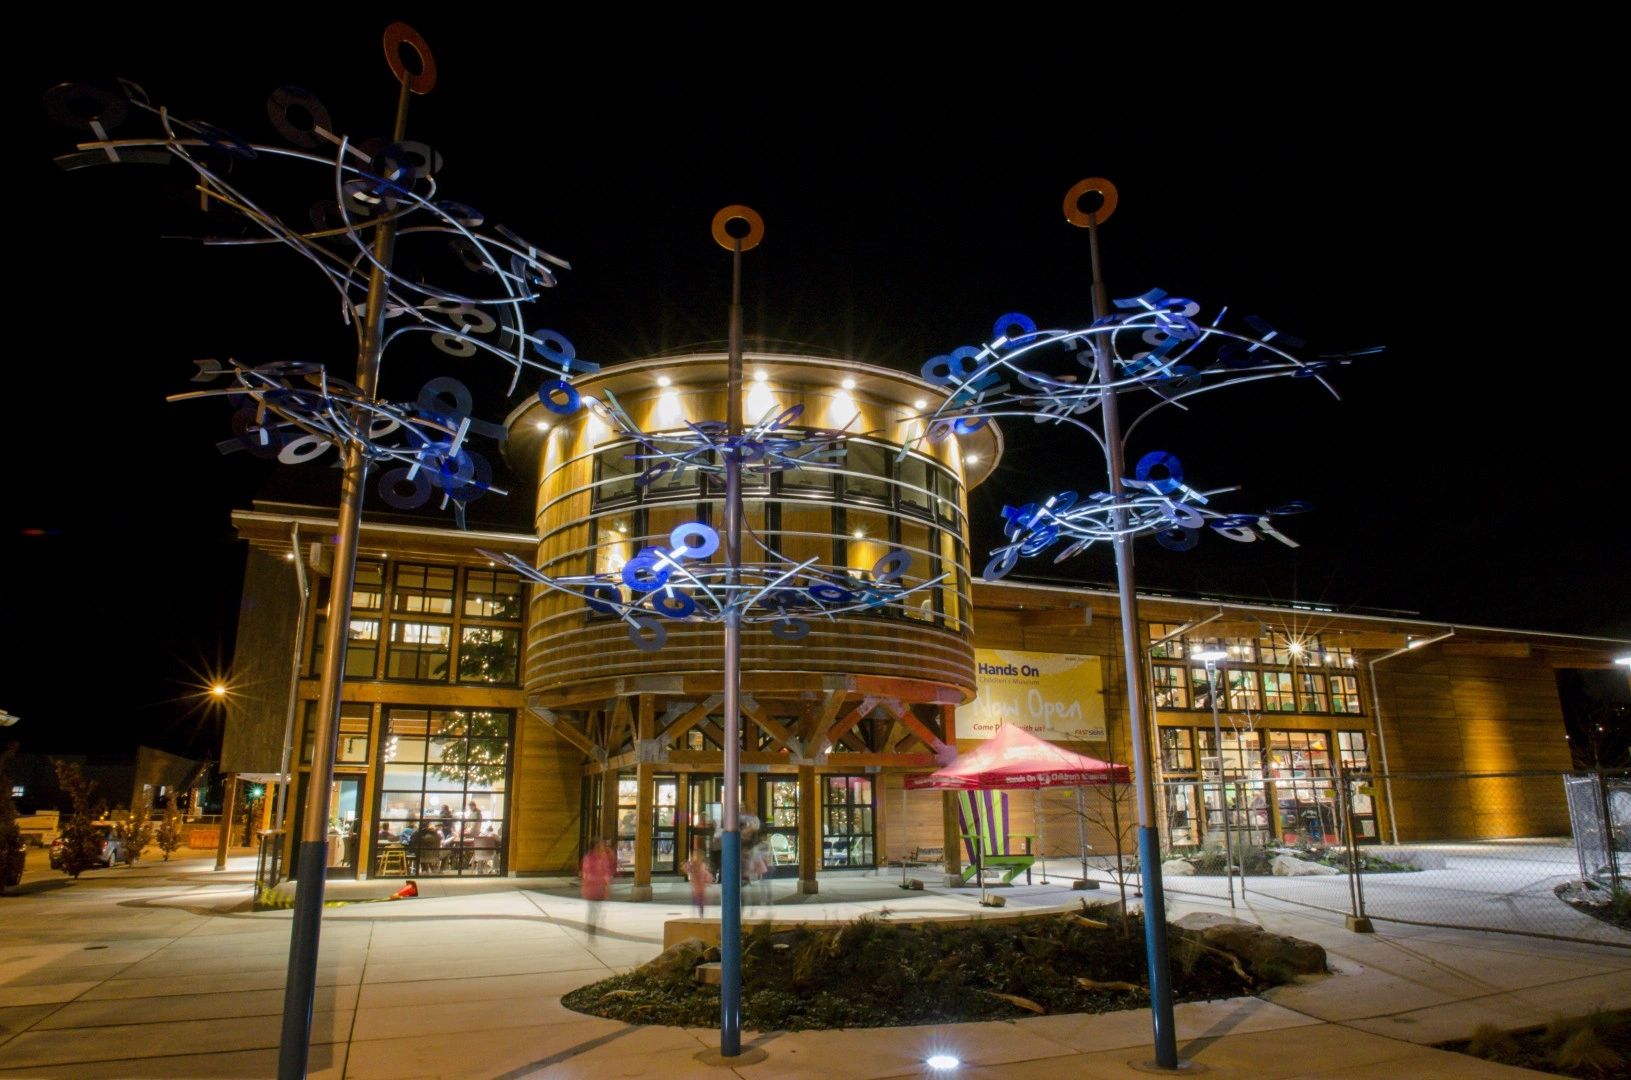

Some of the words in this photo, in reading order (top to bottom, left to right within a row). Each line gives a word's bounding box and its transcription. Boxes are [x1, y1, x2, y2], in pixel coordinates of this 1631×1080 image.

[979, 662, 1018, 676] Hands
[1021, 665, 1039, 677] On
[973, 685, 1020, 717] Now
[1027, 688, 1082, 729] Open
[973, 723, 993, 731] Come
[1026, 774, 1036, 782] On
